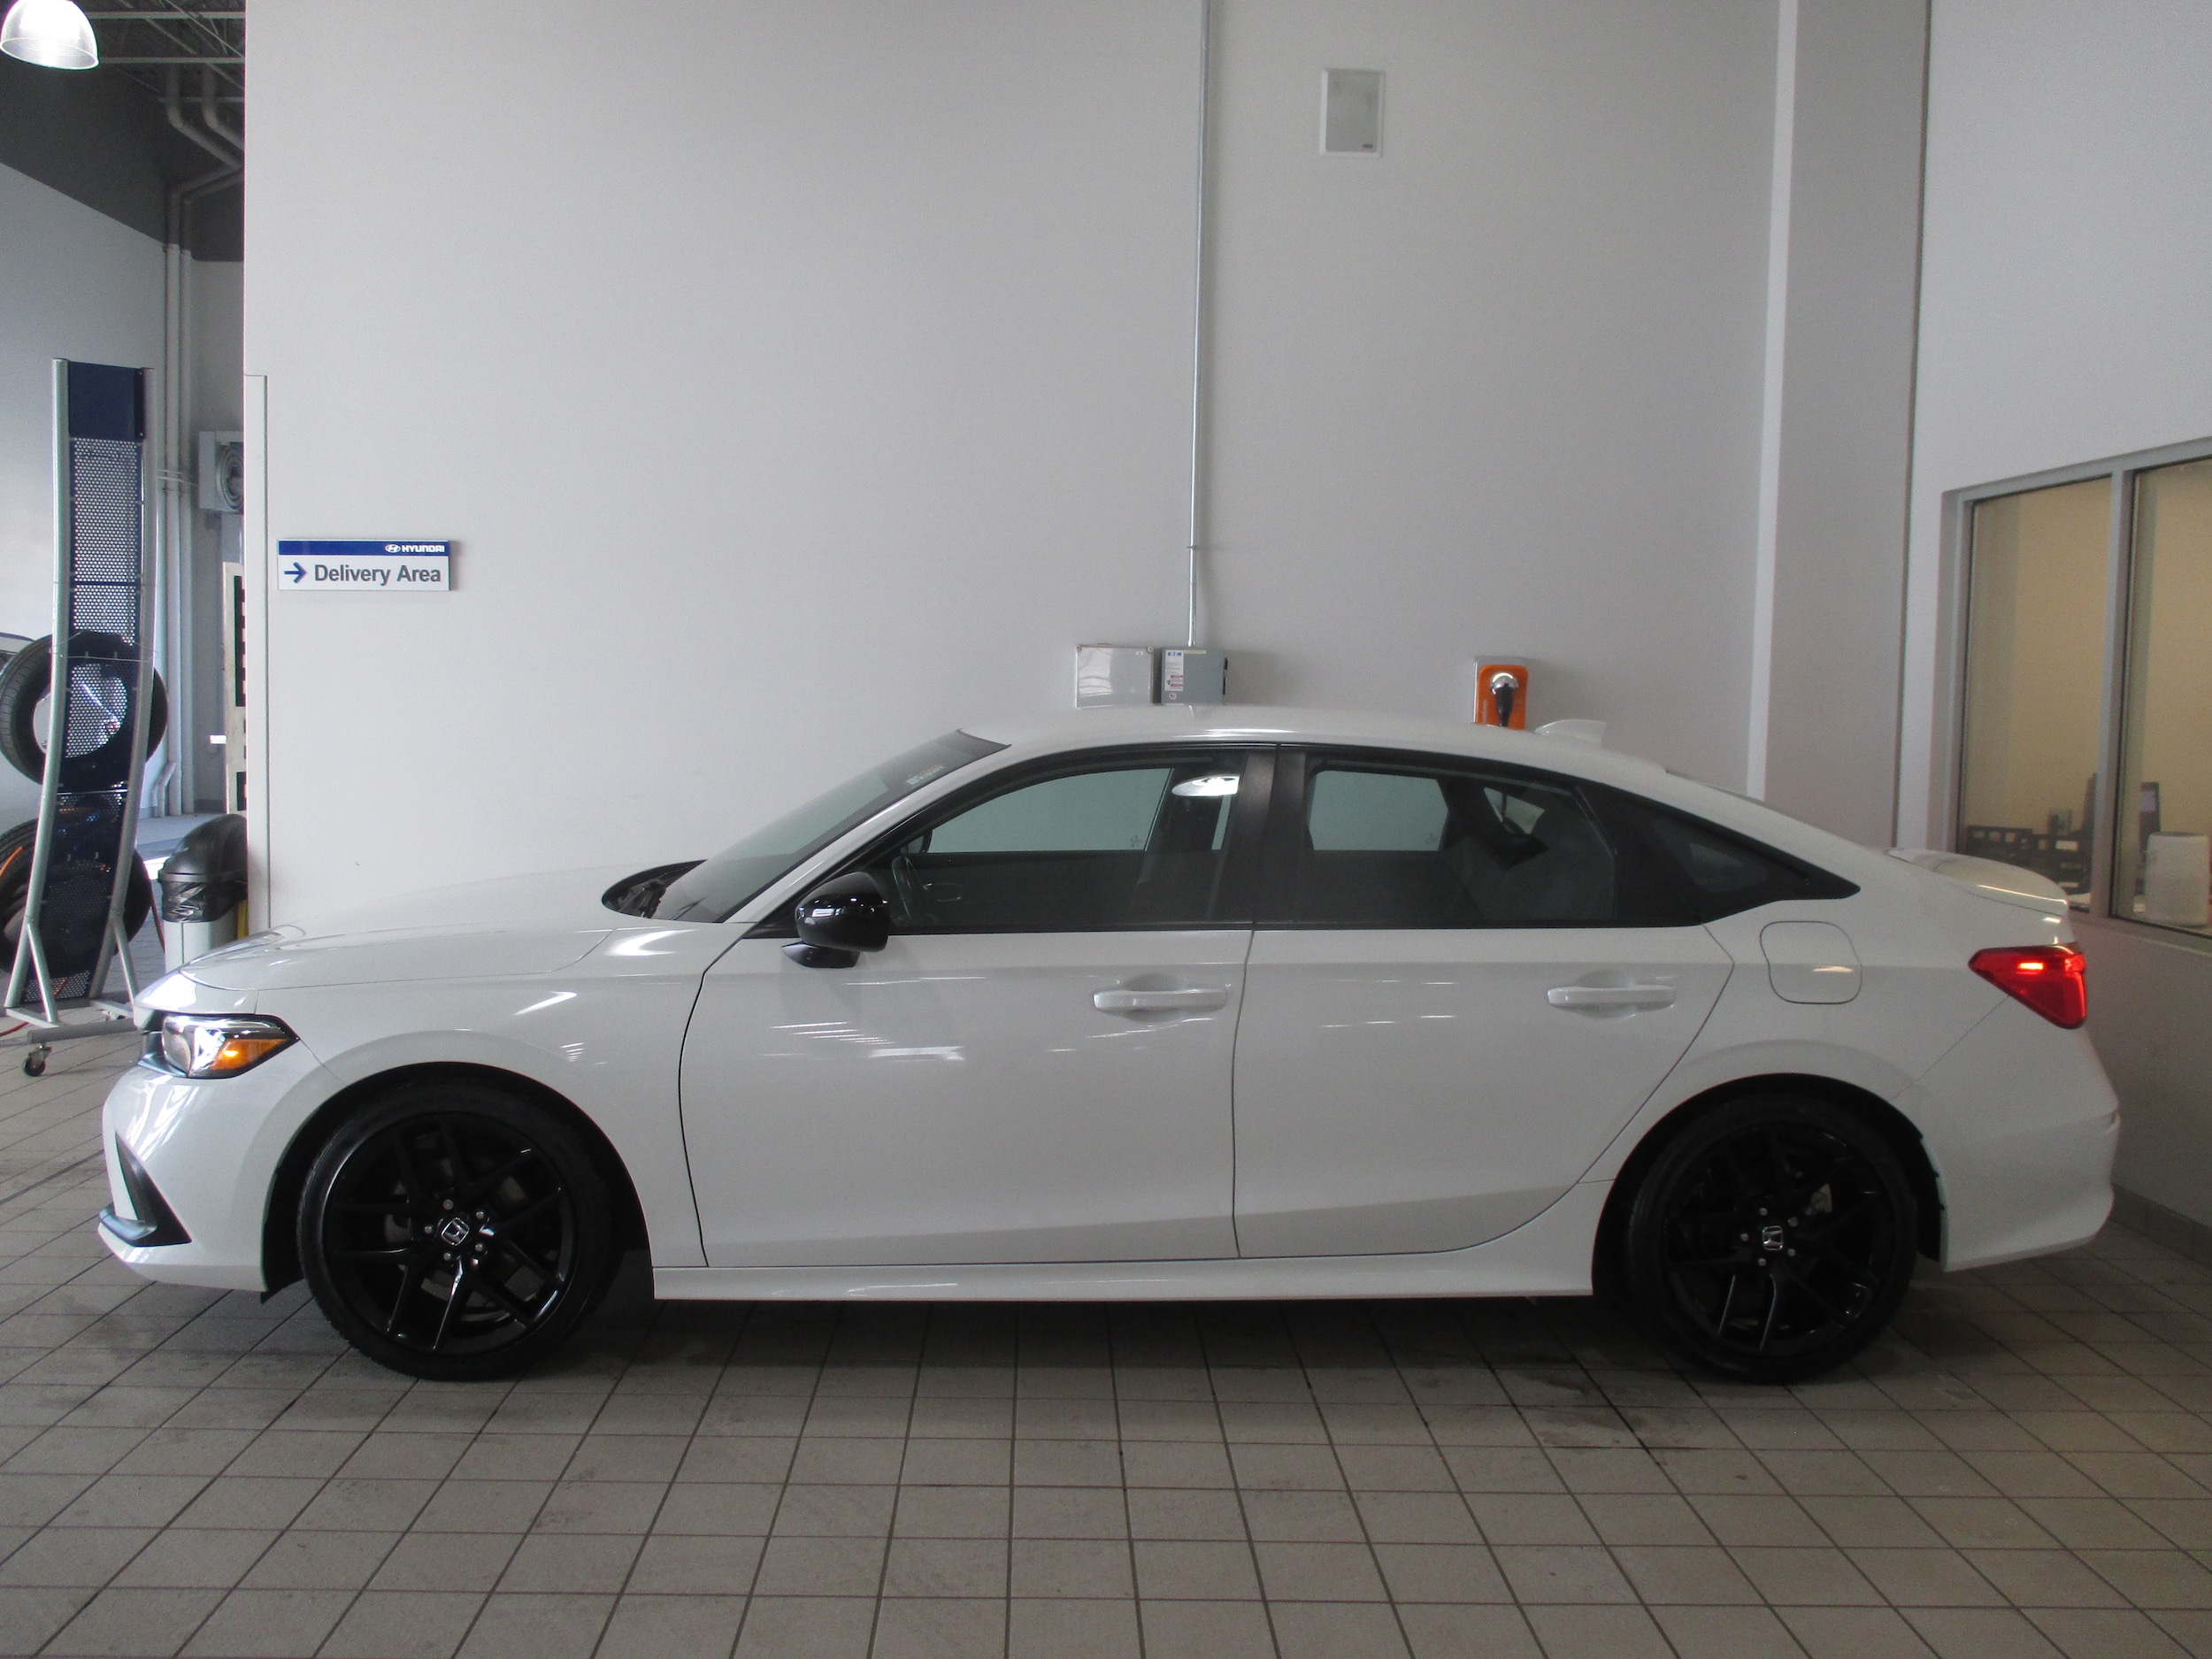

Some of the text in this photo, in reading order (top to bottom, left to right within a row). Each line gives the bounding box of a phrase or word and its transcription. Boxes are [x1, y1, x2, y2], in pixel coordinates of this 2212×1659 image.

[401, 544, 445, 553] HYUNDAI
[314, 565, 441, 586] Delivery Area
